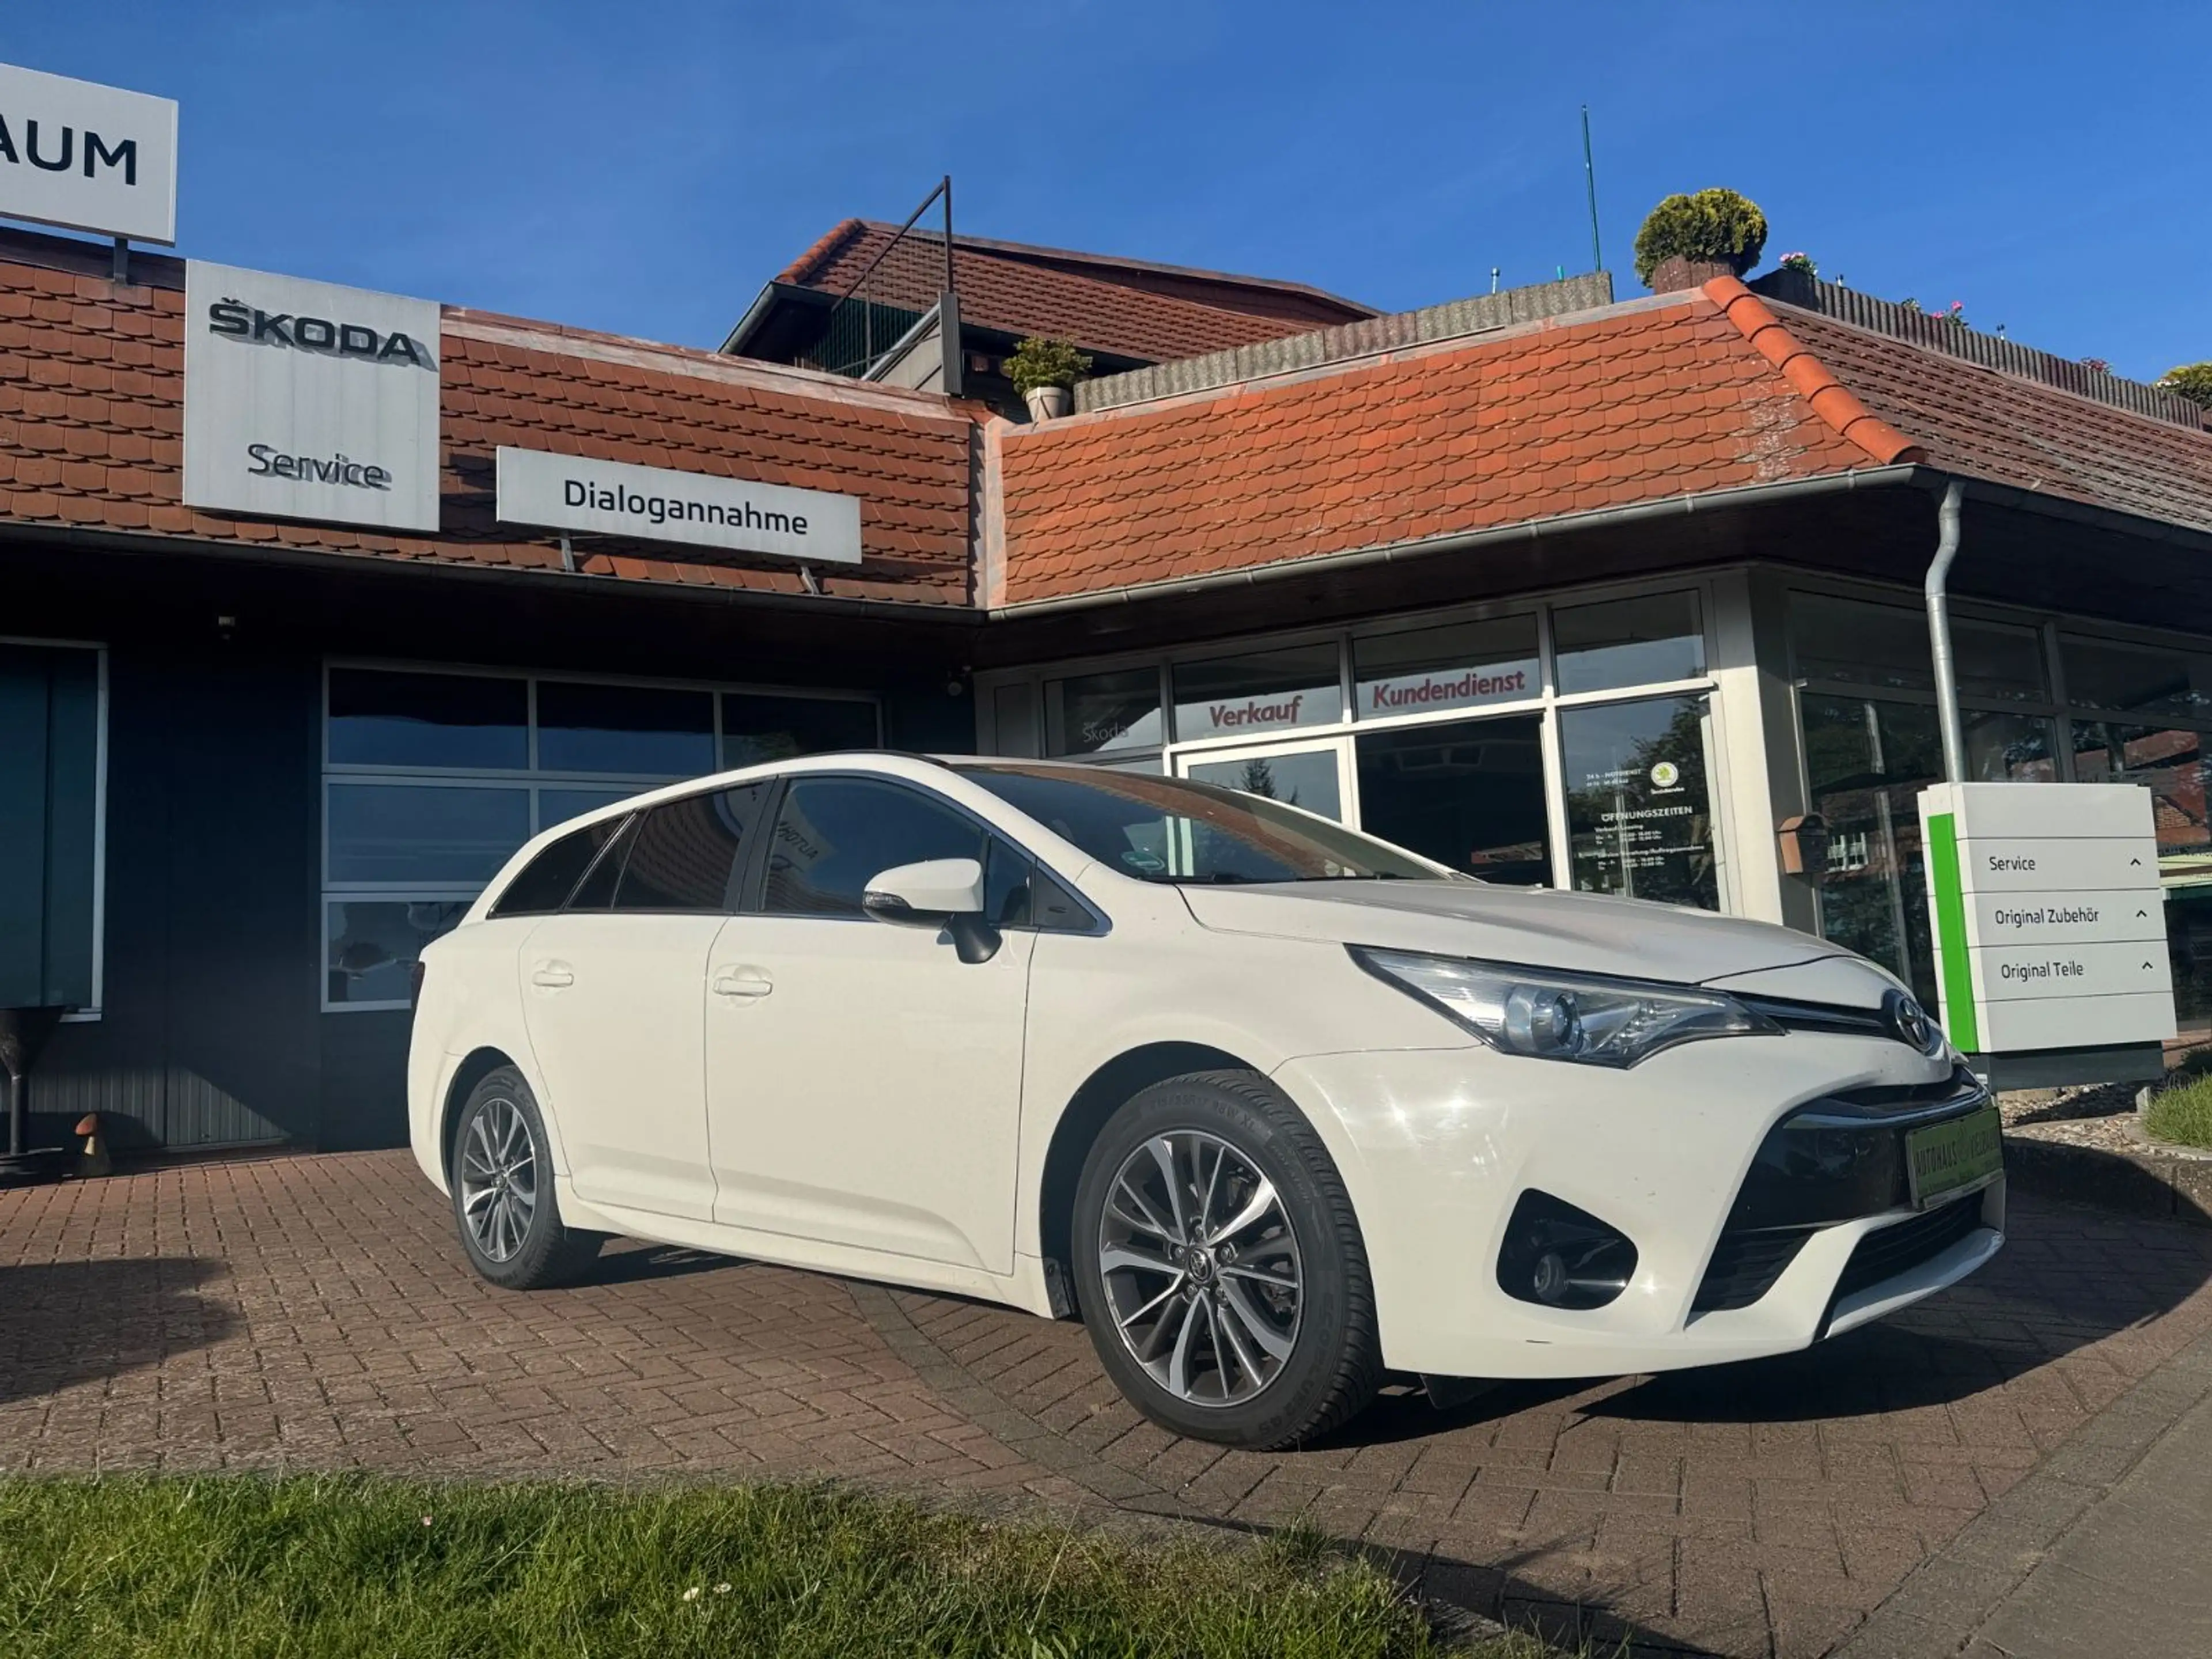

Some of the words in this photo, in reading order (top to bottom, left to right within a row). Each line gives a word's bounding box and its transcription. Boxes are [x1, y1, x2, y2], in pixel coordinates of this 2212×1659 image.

[209, 297, 422, 366] ŠKODA
[247, 443, 385, 488] Service
[564, 479, 808, 535] Dialogannahme
[1373, 670, 1525, 709] Kundendienst
[1210, 695, 1303, 728] Verkauf
[1989, 856, 2036, 872] Service
[1995, 907, 2044, 929] Original
[2048, 906, 2100, 923] Zubehör
[2001, 961, 2051, 983] Original
[2053, 961, 2084, 976] Teile
